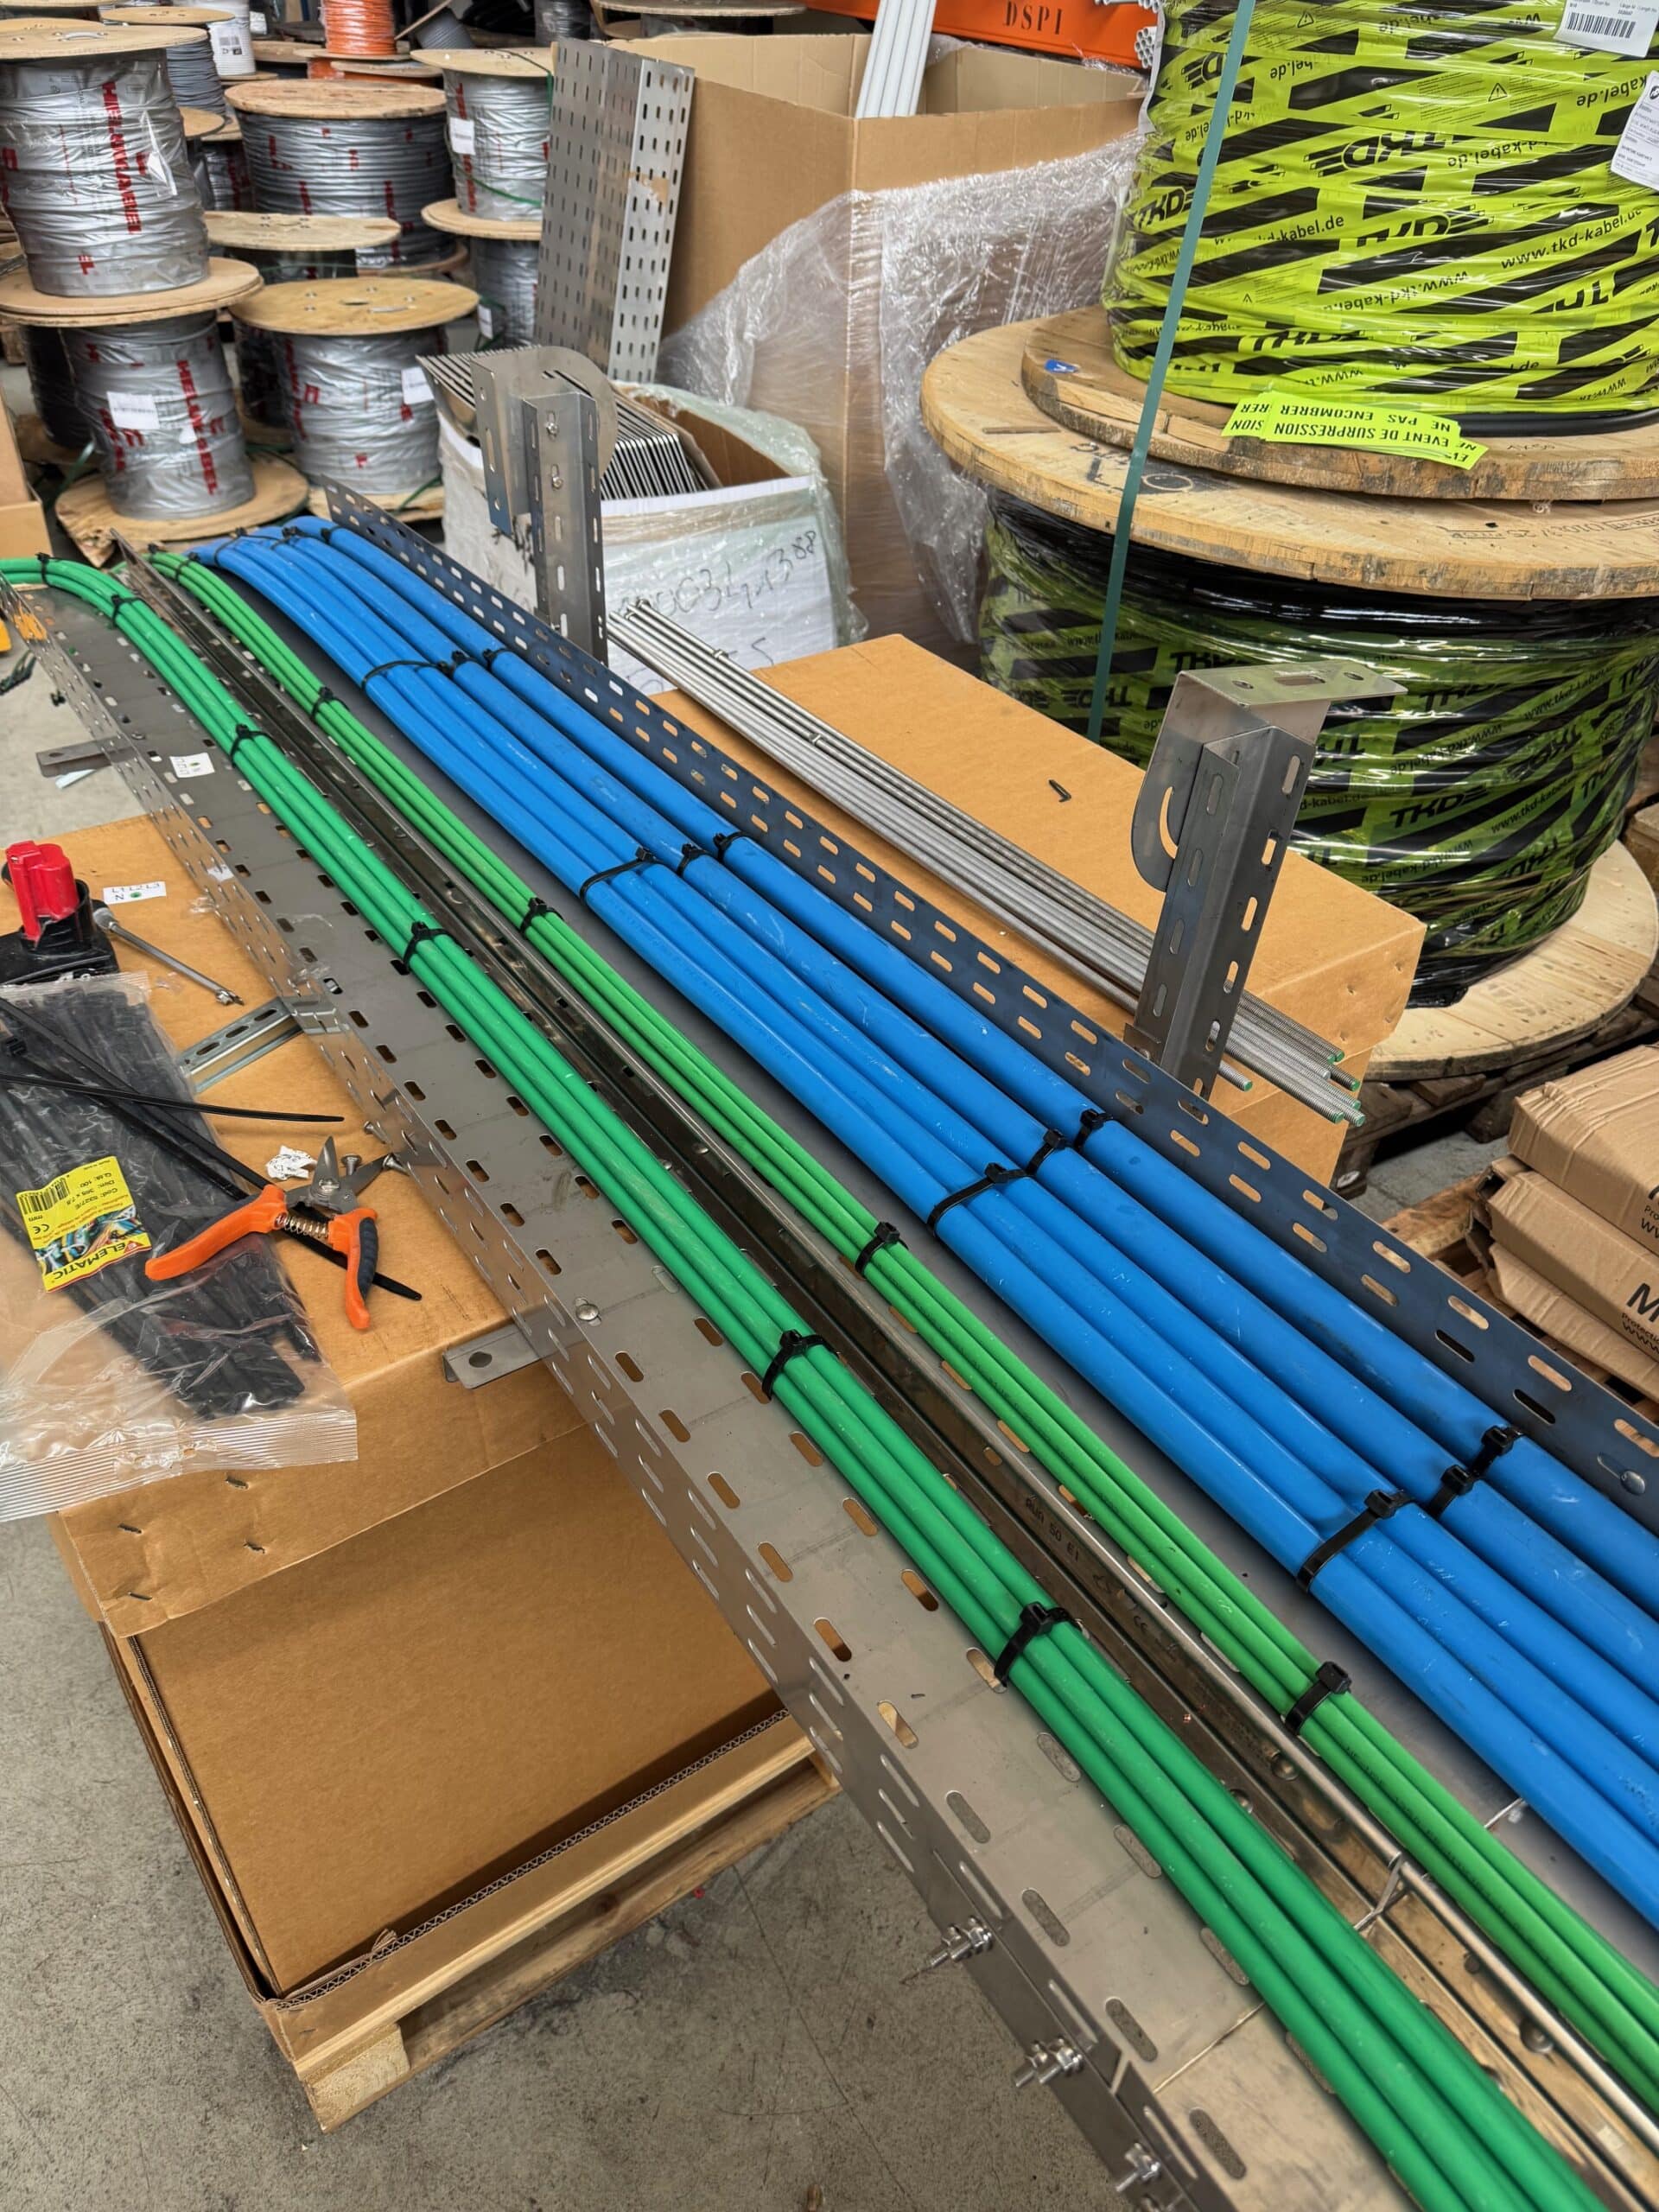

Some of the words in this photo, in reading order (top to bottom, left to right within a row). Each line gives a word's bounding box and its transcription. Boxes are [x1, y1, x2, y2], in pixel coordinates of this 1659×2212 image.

[1003, 1, 1062, 35] DSPI
[1280, 404, 1374, 422] ENCOMBRER
[1388, 414, 1418, 427] PAS
[1274, 423, 1376, 439] SURPRESSION
[1431, 420, 1452, 432] NE
[1380, 429, 1399, 442] DE
[1405, 430, 1450, 448] EVENT
[1390, 787, 1466, 828] TKD
[53, 1242, 126, 1280] ELEMATIC
